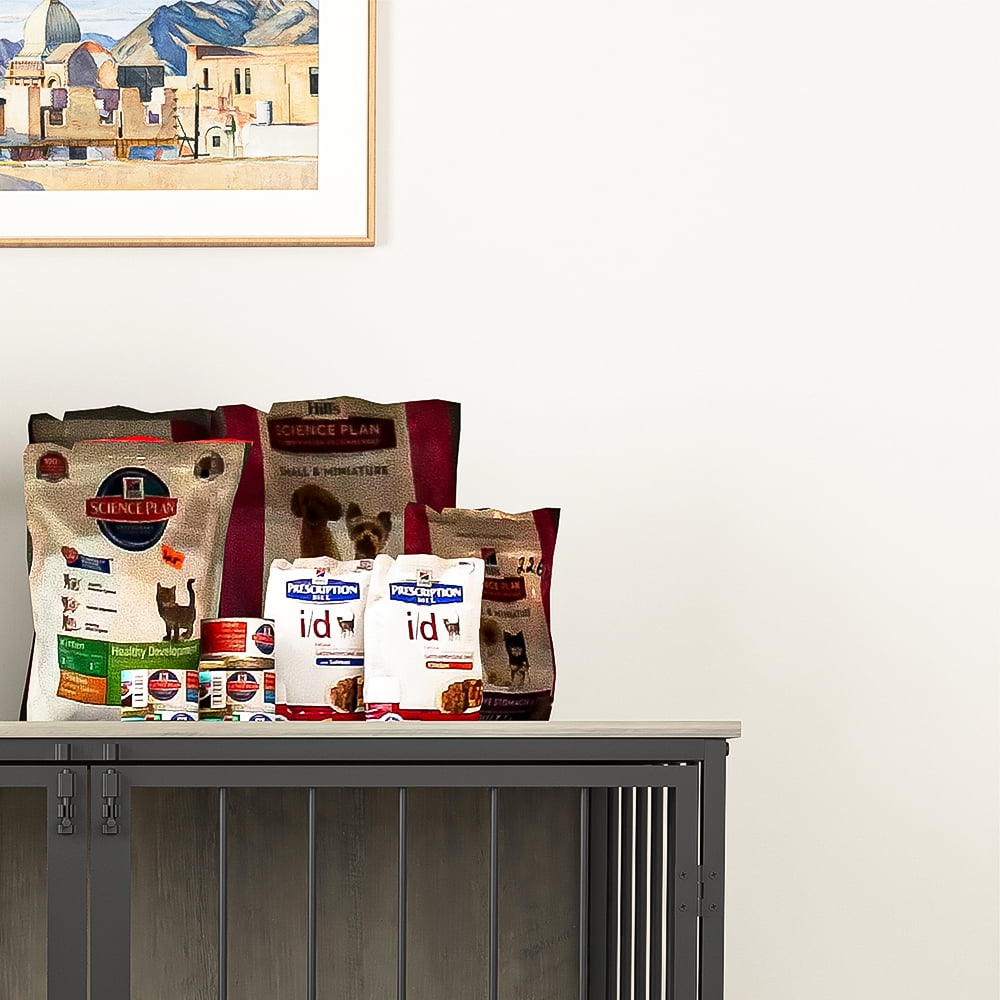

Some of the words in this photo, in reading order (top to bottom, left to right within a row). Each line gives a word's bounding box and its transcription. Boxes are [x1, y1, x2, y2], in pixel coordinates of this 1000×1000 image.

[276, 423, 336, 437] SCIENCE
[341, 423, 381, 437] PLAN
[90, 501, 146, 516] SCIENCE
[300, 609, 331, 638] i/d
[406, 611, 439, 641] i/d
[111, 646, 146, 660] Healthy
